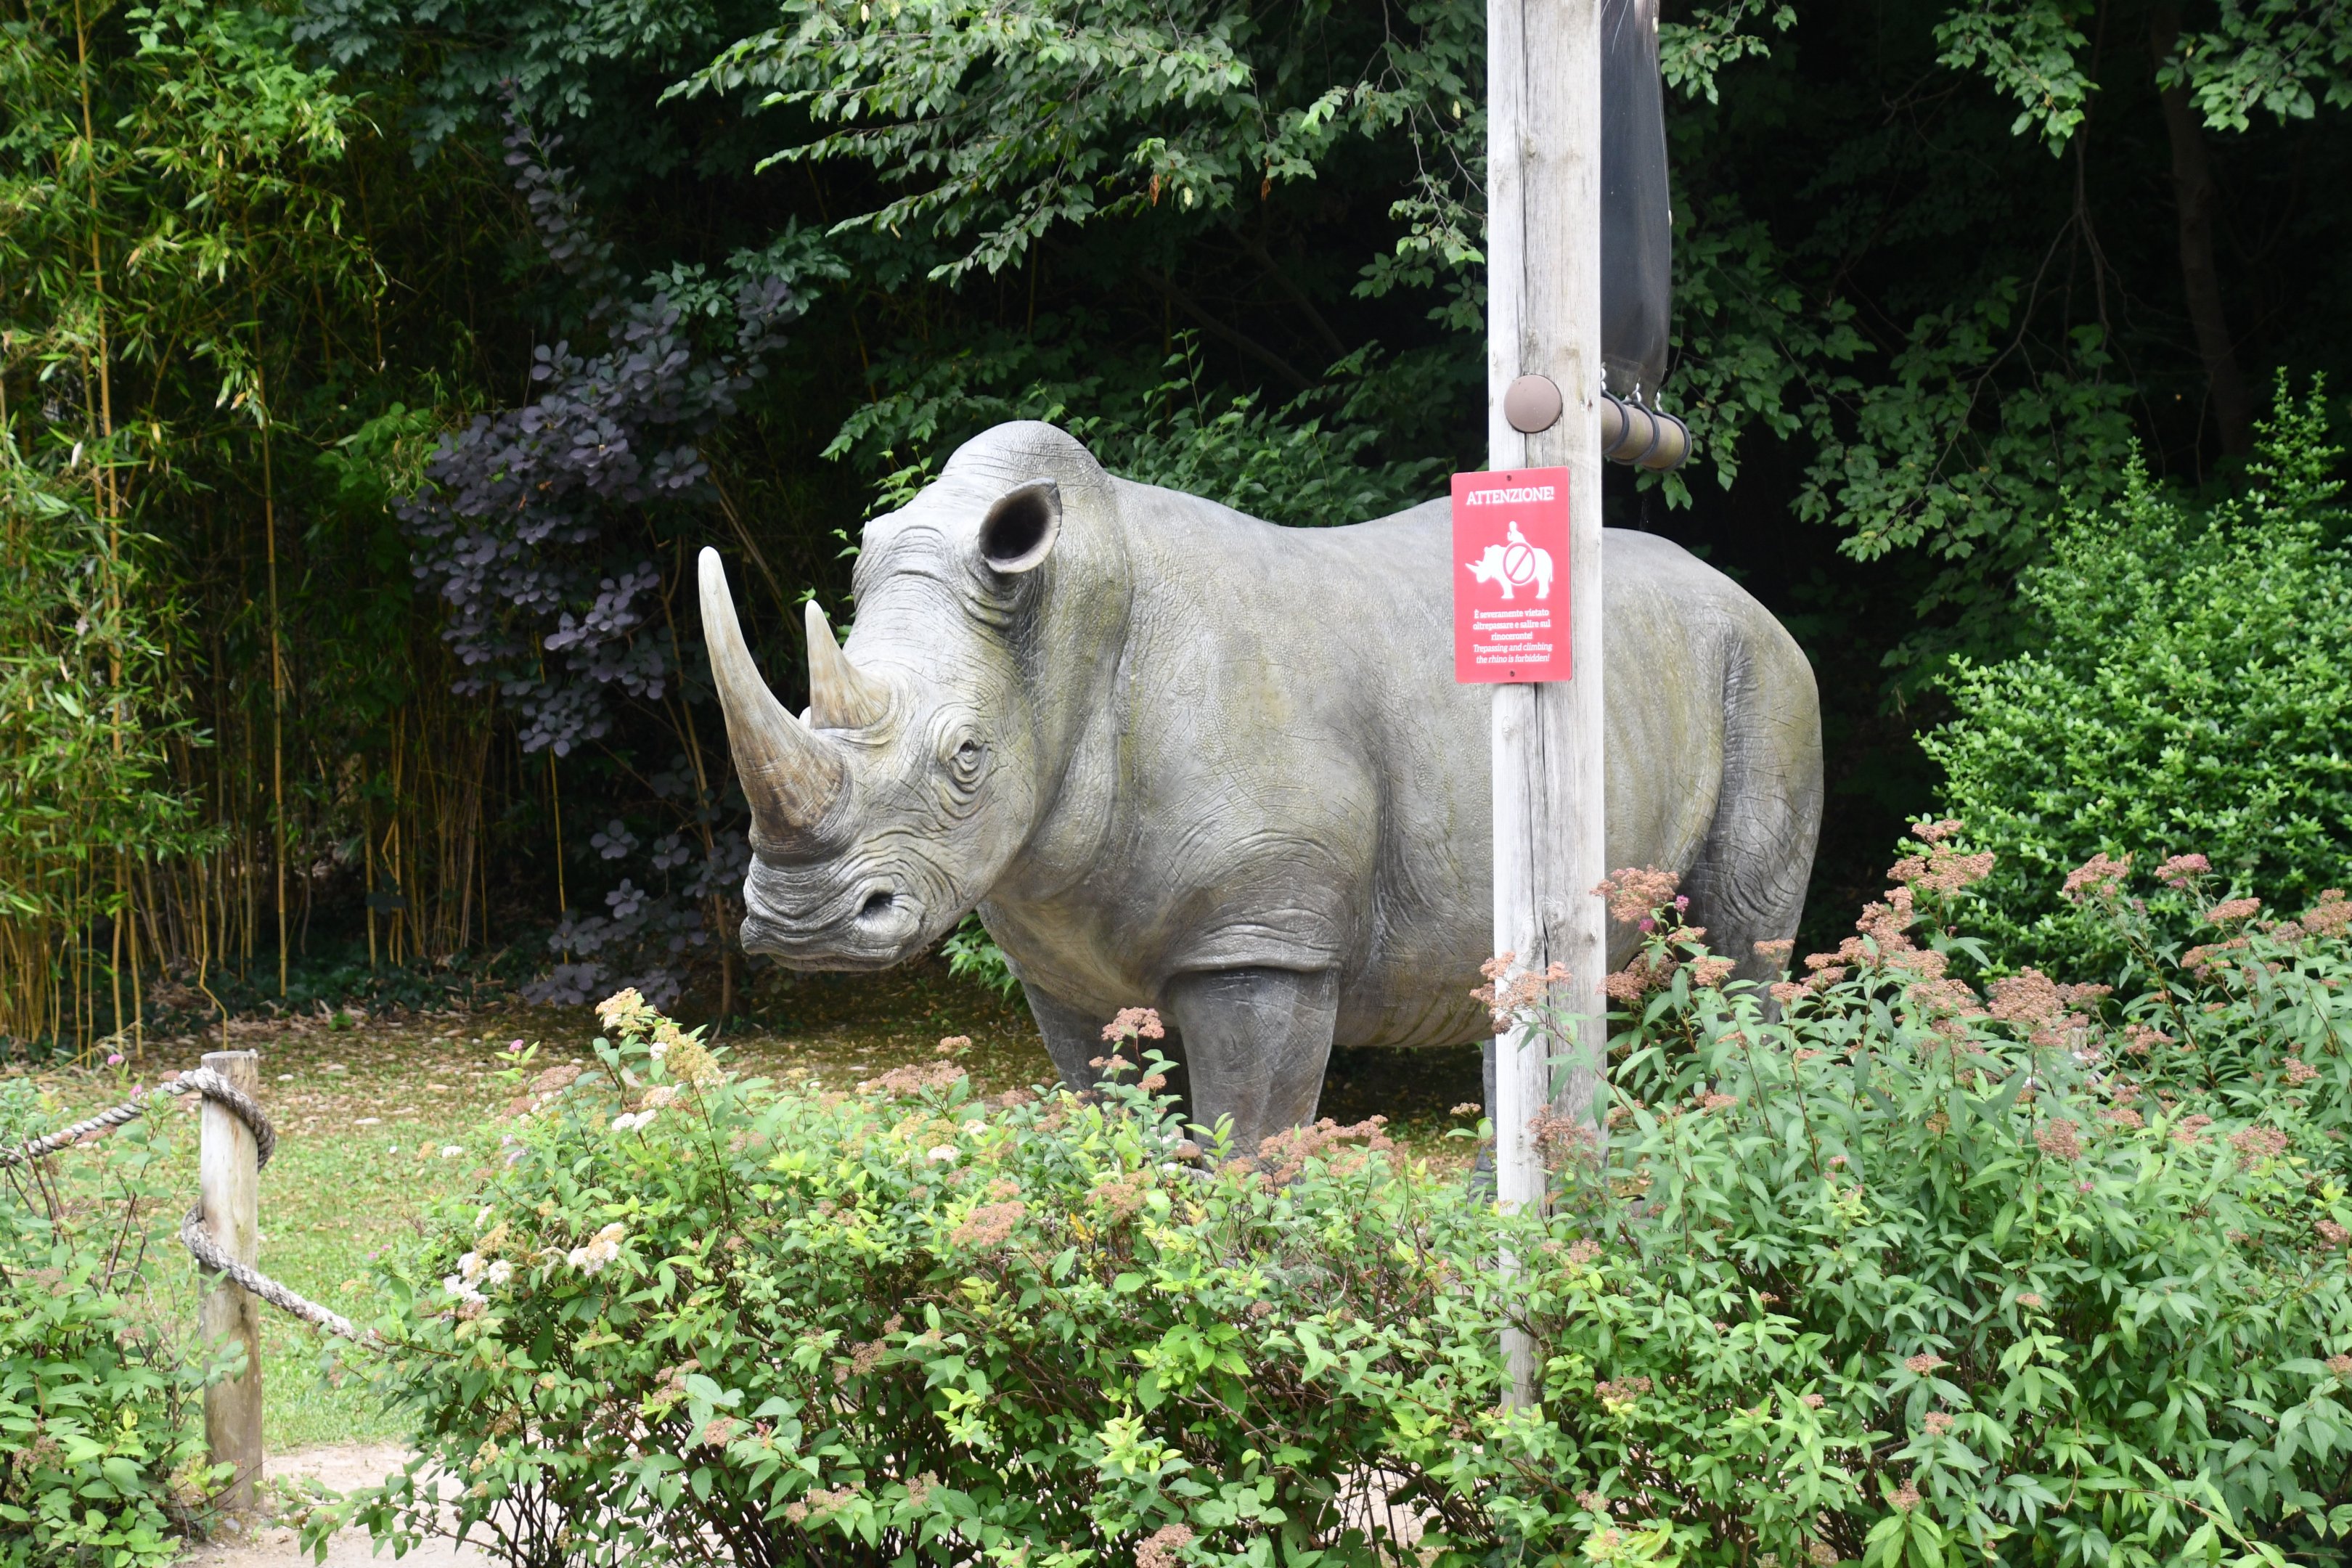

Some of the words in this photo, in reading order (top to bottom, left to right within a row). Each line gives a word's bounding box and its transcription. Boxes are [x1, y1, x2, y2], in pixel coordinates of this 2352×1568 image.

[1466, 486, 1554, 505] ATTENZIONE!
[1479, 610, 1524, 618] severamente
[1524, 608, 1550, 617] vietato
[1473, 621, 1514, 631] oltrepassare
[1519, 619, 1540, 629] salire
[1490, 632, 1533, 640] rinoceronte!
[1523, 642, 1553, 652] climbing
[1476, 655, 1487, 663] the
[1514, 654, 1550, 663] forbidden!
